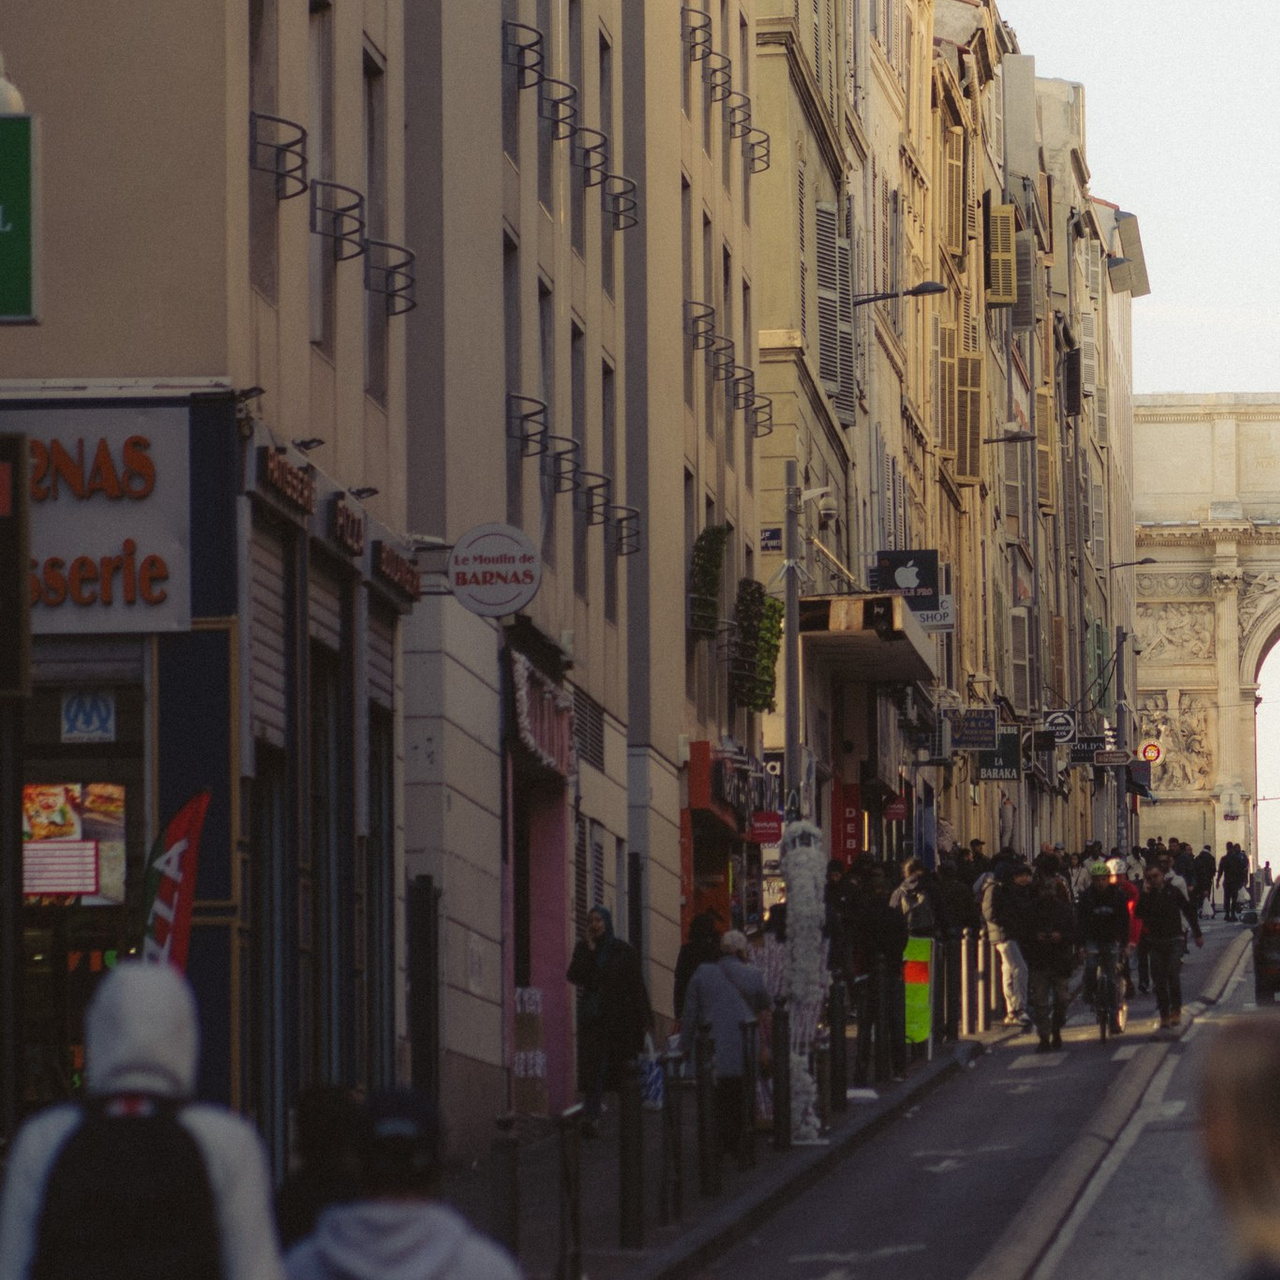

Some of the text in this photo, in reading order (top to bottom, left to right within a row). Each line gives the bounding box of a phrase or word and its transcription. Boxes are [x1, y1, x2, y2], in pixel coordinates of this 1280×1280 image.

[454, 553, 535, 566] Le Moulin de
[455, 569, 535, 586] BARNAS
[919, 612, 949, 623] SHOP
[994, 757, 1004, 767] LA
[980, 768, 1018, 779] BARAKA
